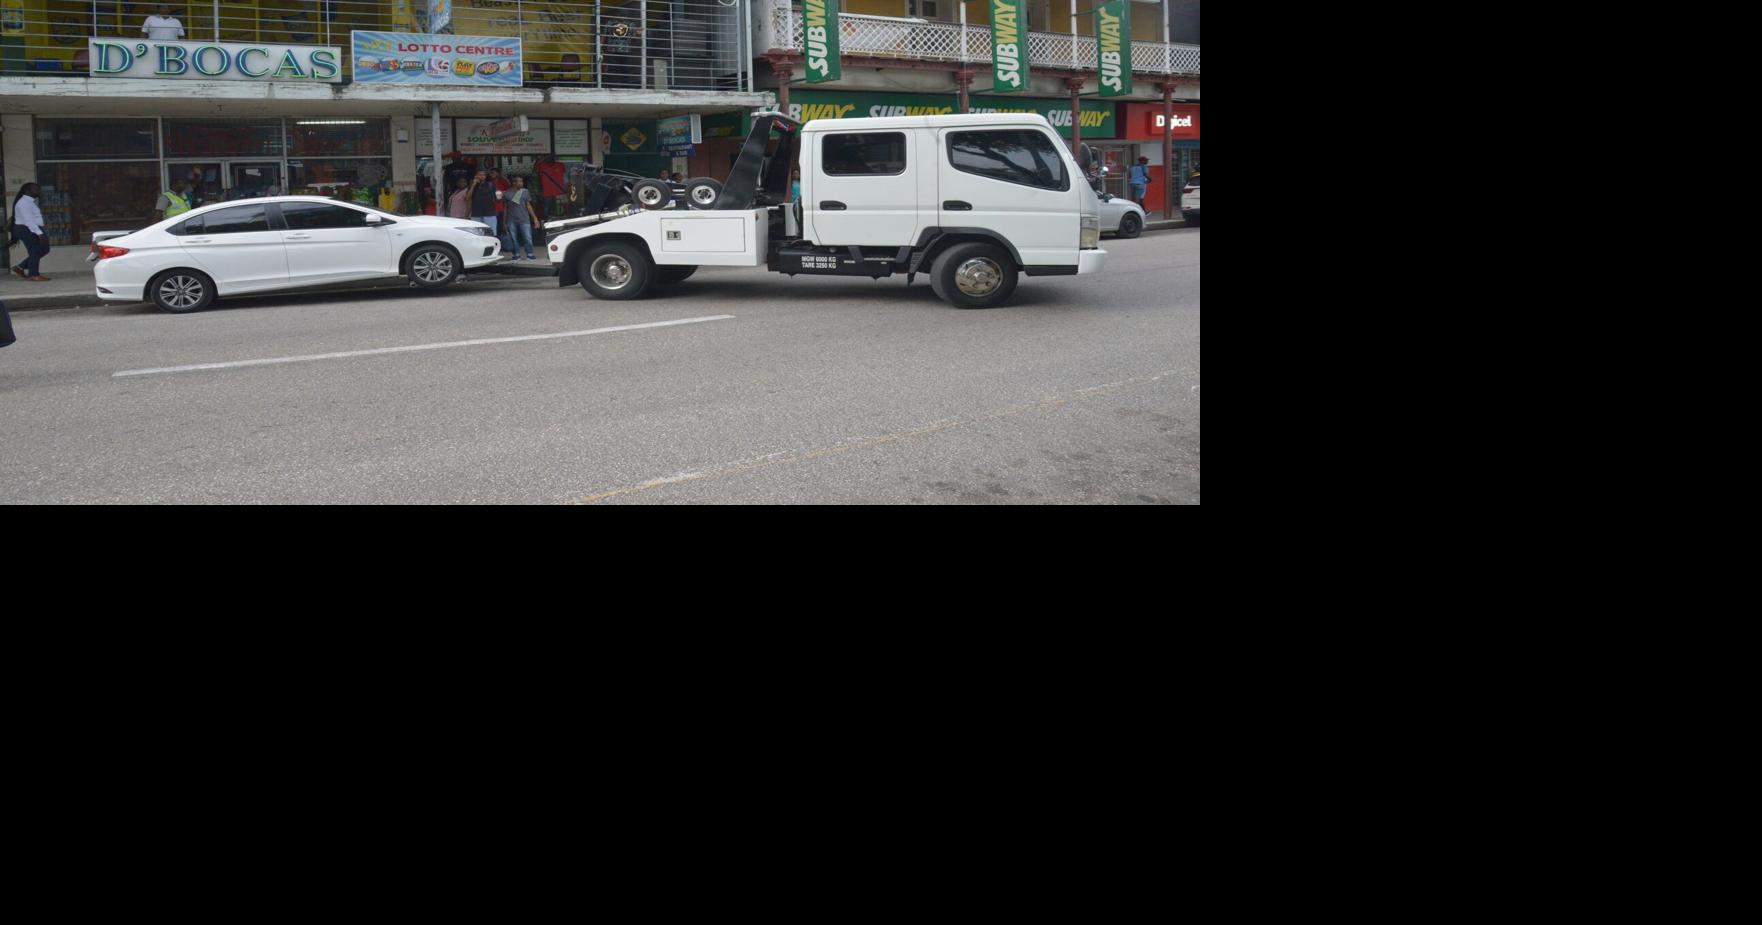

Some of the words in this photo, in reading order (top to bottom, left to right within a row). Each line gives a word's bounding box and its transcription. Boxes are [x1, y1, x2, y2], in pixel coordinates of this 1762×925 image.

[398, 43, 452, 54] LOTTO
[455, 45, 514, 56] CENTRE
[994, 0, 1021, 88] SUBWAY
[1098, 6, 1122, 92] SUBWAY
